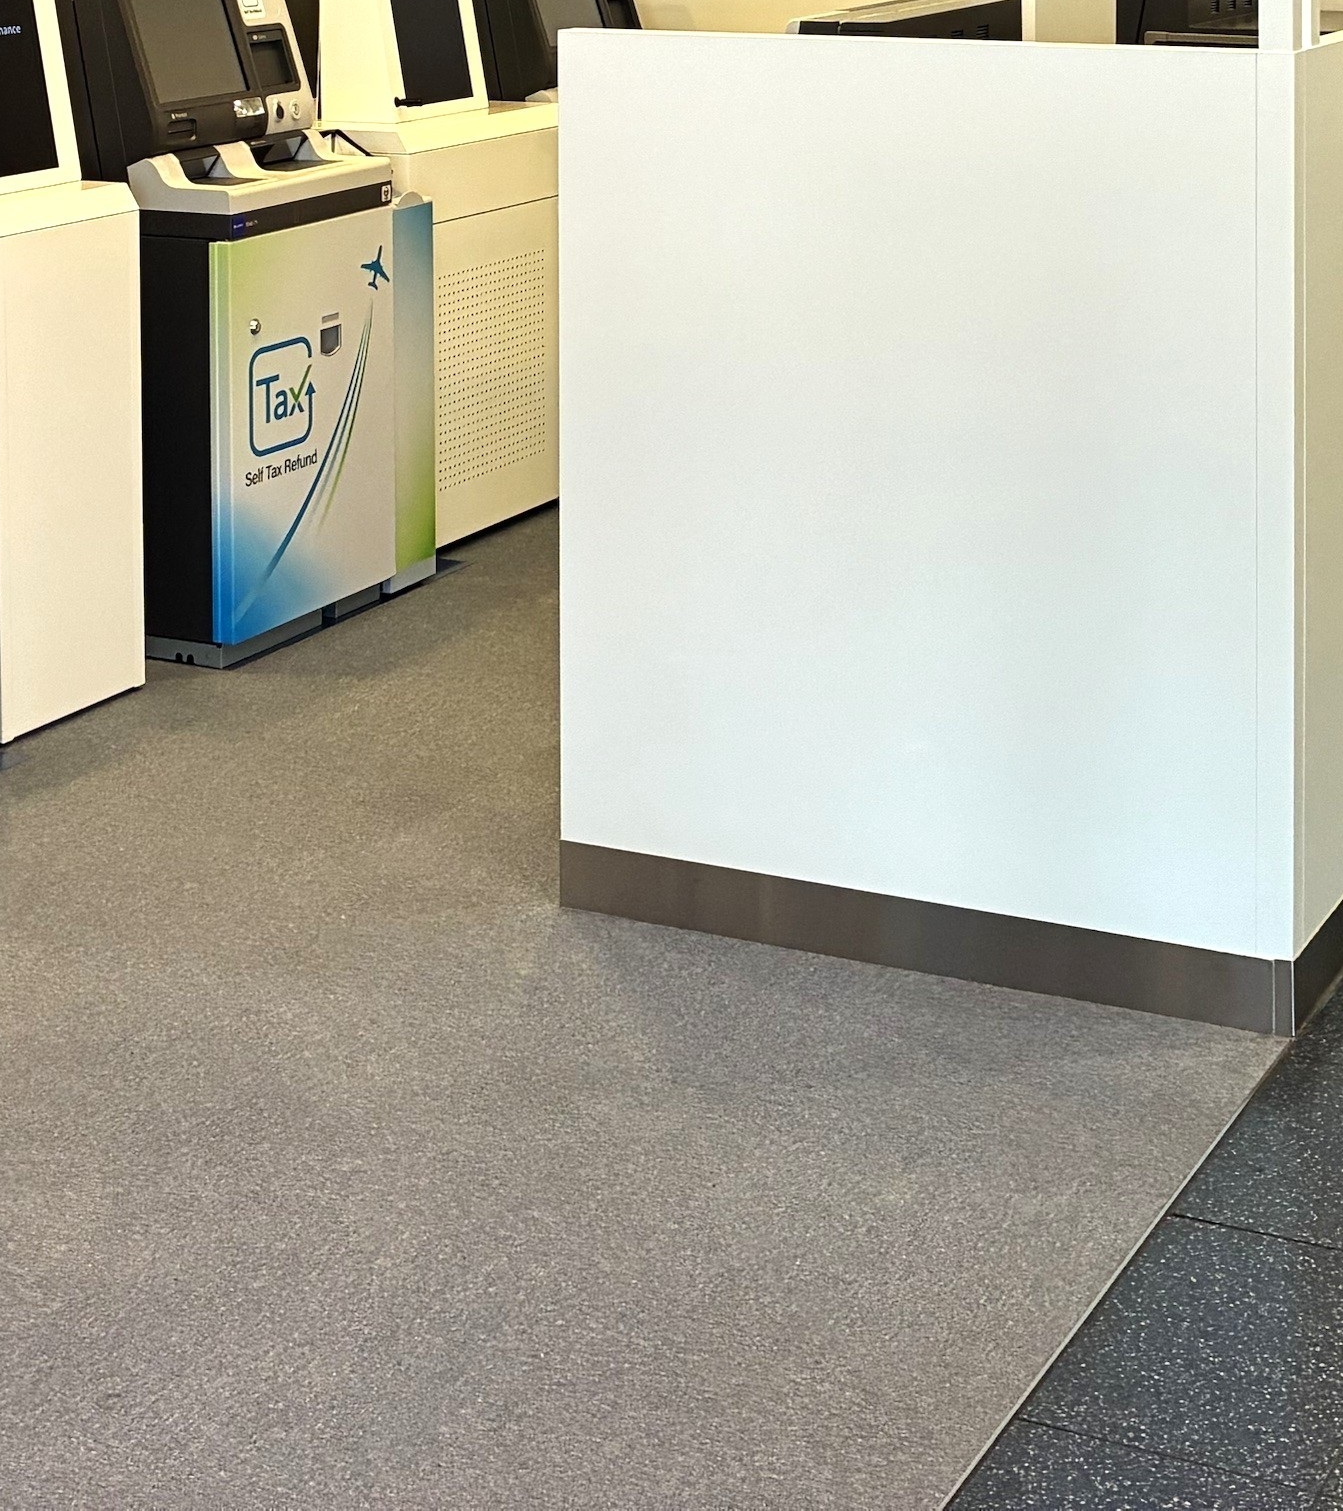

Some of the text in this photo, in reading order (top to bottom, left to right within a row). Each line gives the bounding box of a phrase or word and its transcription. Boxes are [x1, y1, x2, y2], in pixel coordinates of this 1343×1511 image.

[256, 363, 312, 424] Tax
[245, 449, 318, 487] Self Tax Refund
